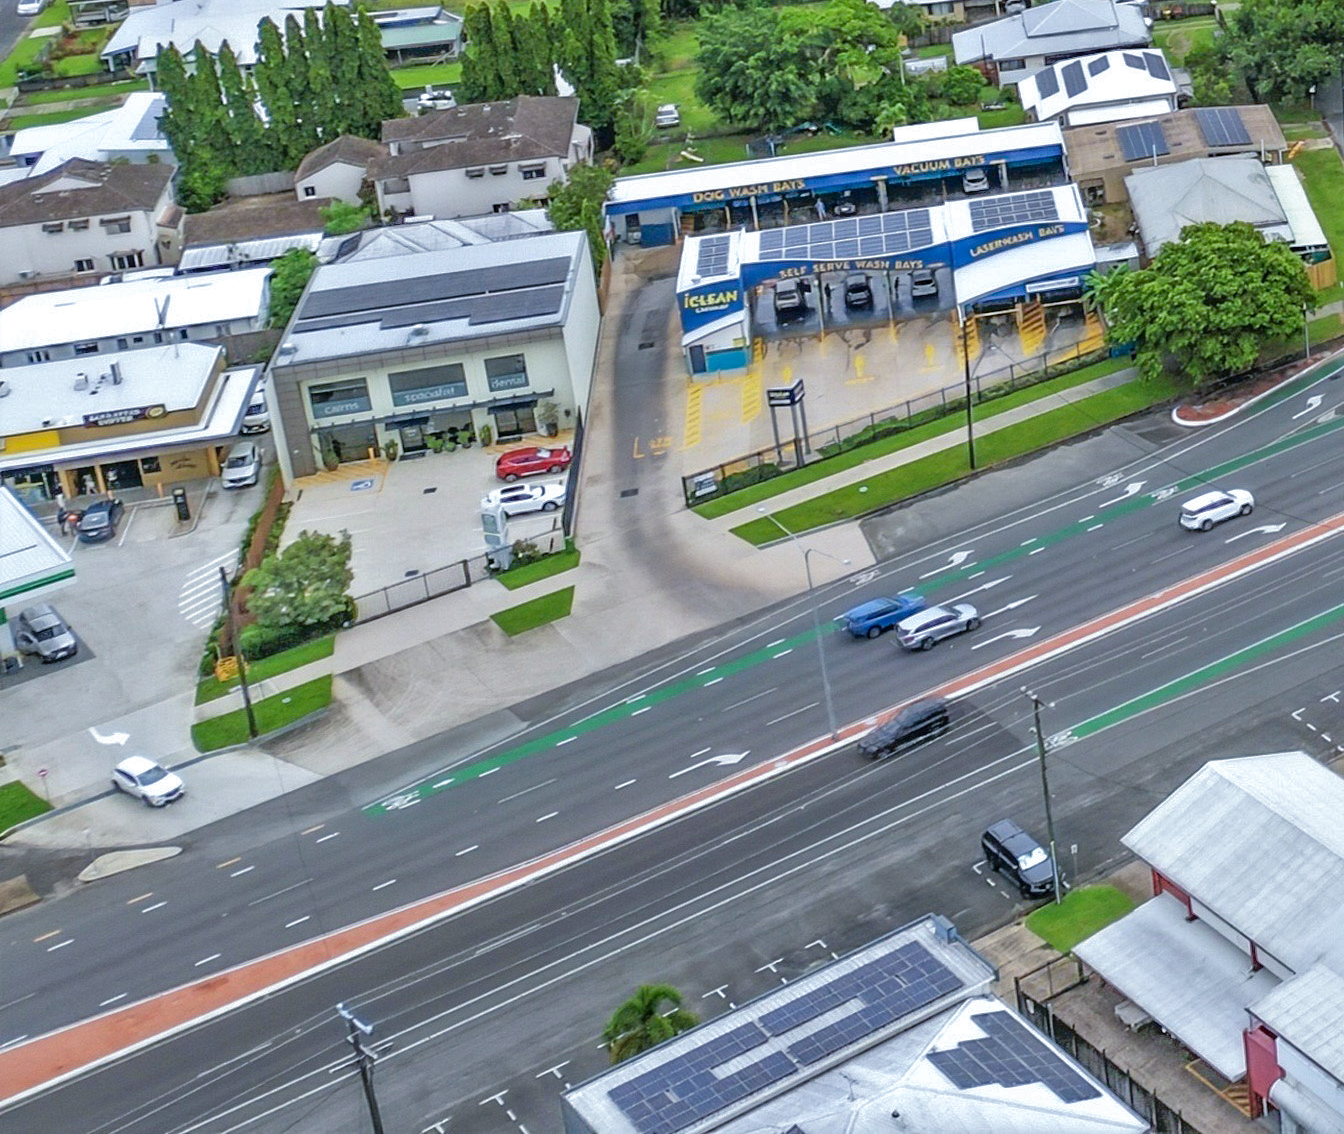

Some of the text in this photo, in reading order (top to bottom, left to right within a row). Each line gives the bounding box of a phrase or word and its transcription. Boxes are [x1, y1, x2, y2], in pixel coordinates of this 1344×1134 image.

[893, 154, 986, 175] VACUUM BAYS
[692, 178, 806, 204] DOG WASH BAYS
[1038, 224, 1066, 238] BAYS
[779, 259, 924, 279] SELF SERVE WASH BAYS
